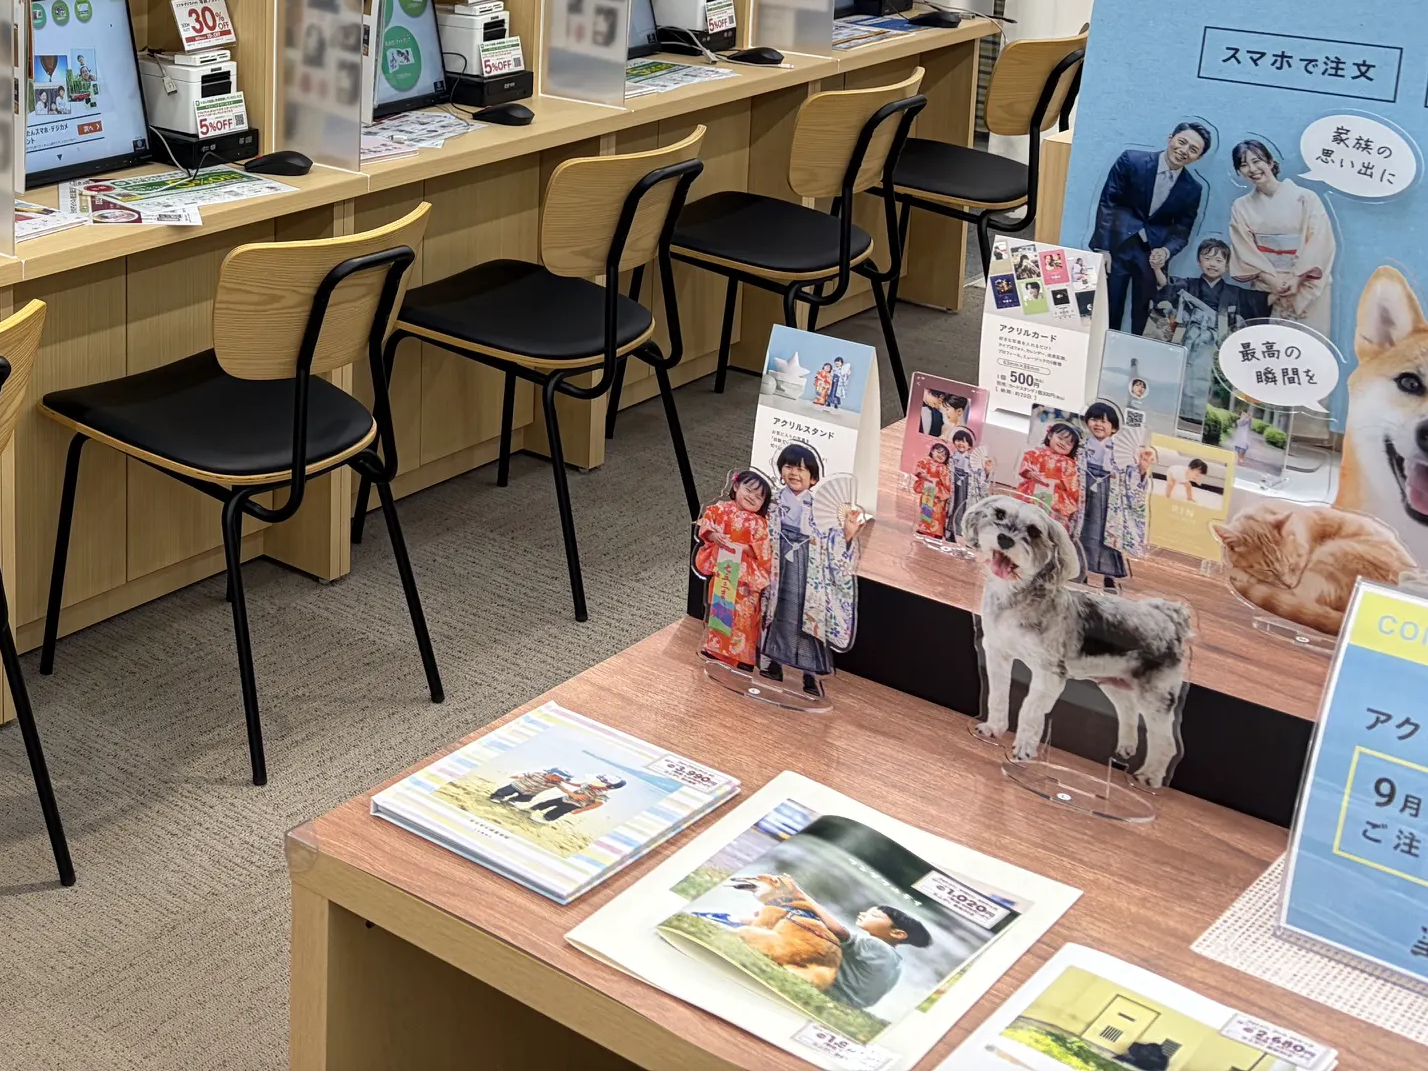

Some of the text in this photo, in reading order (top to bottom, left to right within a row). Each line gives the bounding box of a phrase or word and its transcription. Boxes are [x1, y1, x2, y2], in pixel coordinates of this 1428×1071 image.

[484, 59, 512, 74] 5%OFF
[1221, 46, 1377, 82] スマホで注文
[200, 114, 233, 136] 5%OFF
[1331, 126, 1393, 159] 家族の
[1315, 149, 1397, 185] 思い出に
[1000, 324, 1057, 342] アクリルカード
[1239, 342, 1302, 363] 最高の
[1256, 367, 1318, 386] 瞬間を
[774, 417, 834, 439] アクリルスタンド
[1366, 707, 1420, 742] アク
[1374, 777, 1422, 818] 9月
[1361, 820, 1420, 858] ご注
